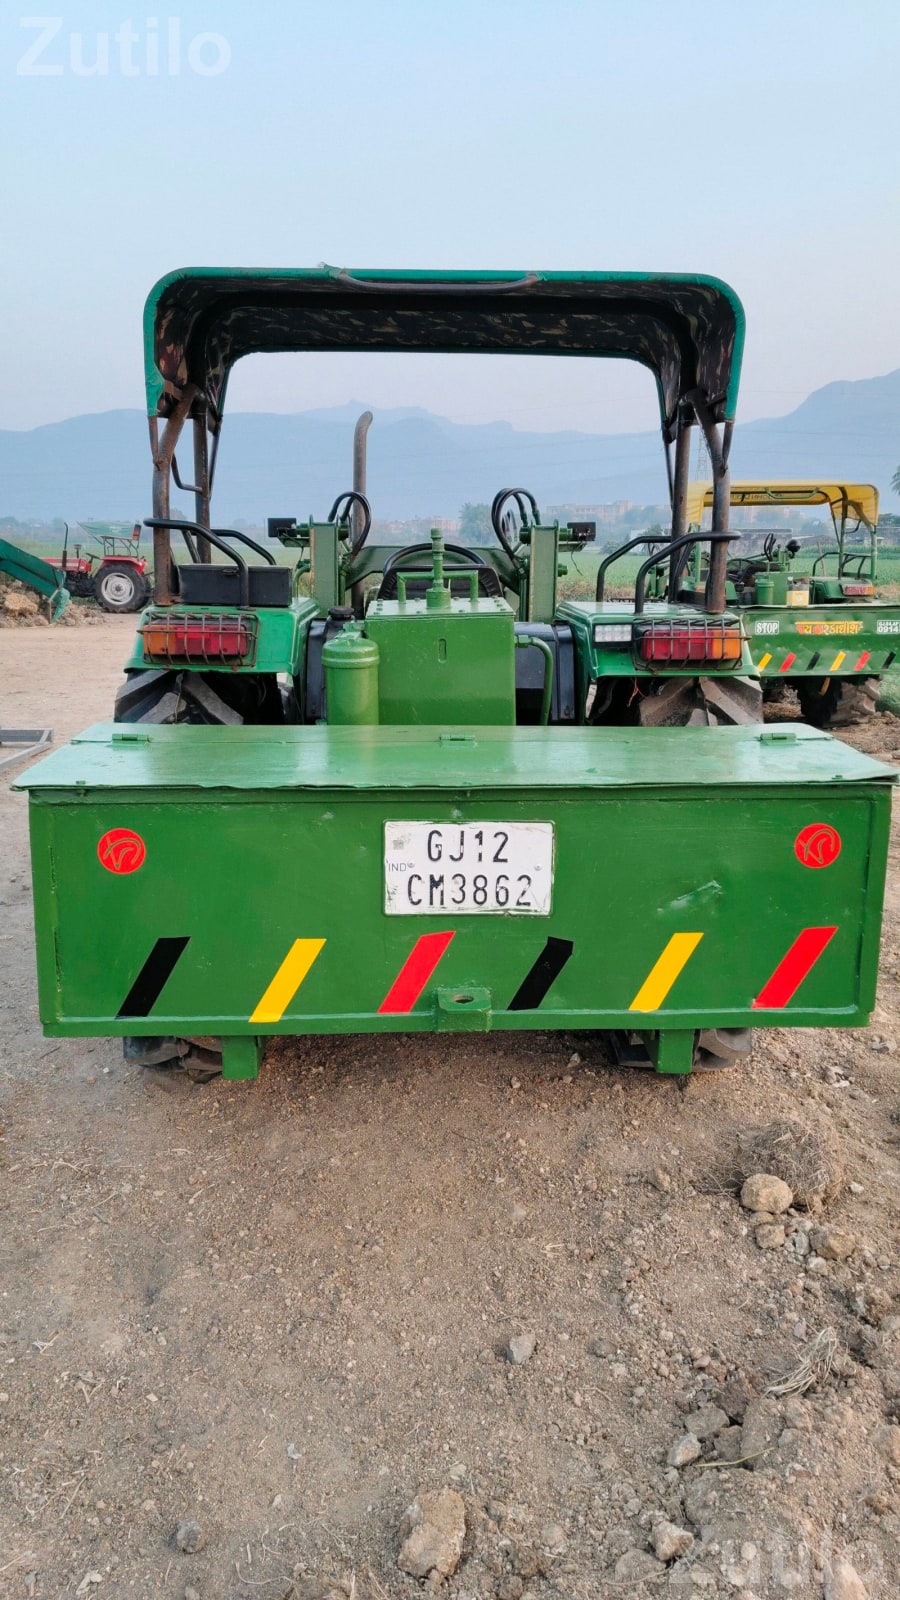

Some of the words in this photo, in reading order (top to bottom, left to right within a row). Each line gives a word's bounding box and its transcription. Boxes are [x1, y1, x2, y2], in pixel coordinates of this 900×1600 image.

[756, 622, 778, 634] STOP
[427, 829, 509, 863] GJ12
[388, 862, 407, 872] IND
[407, 873, 532, 907] CM3862
